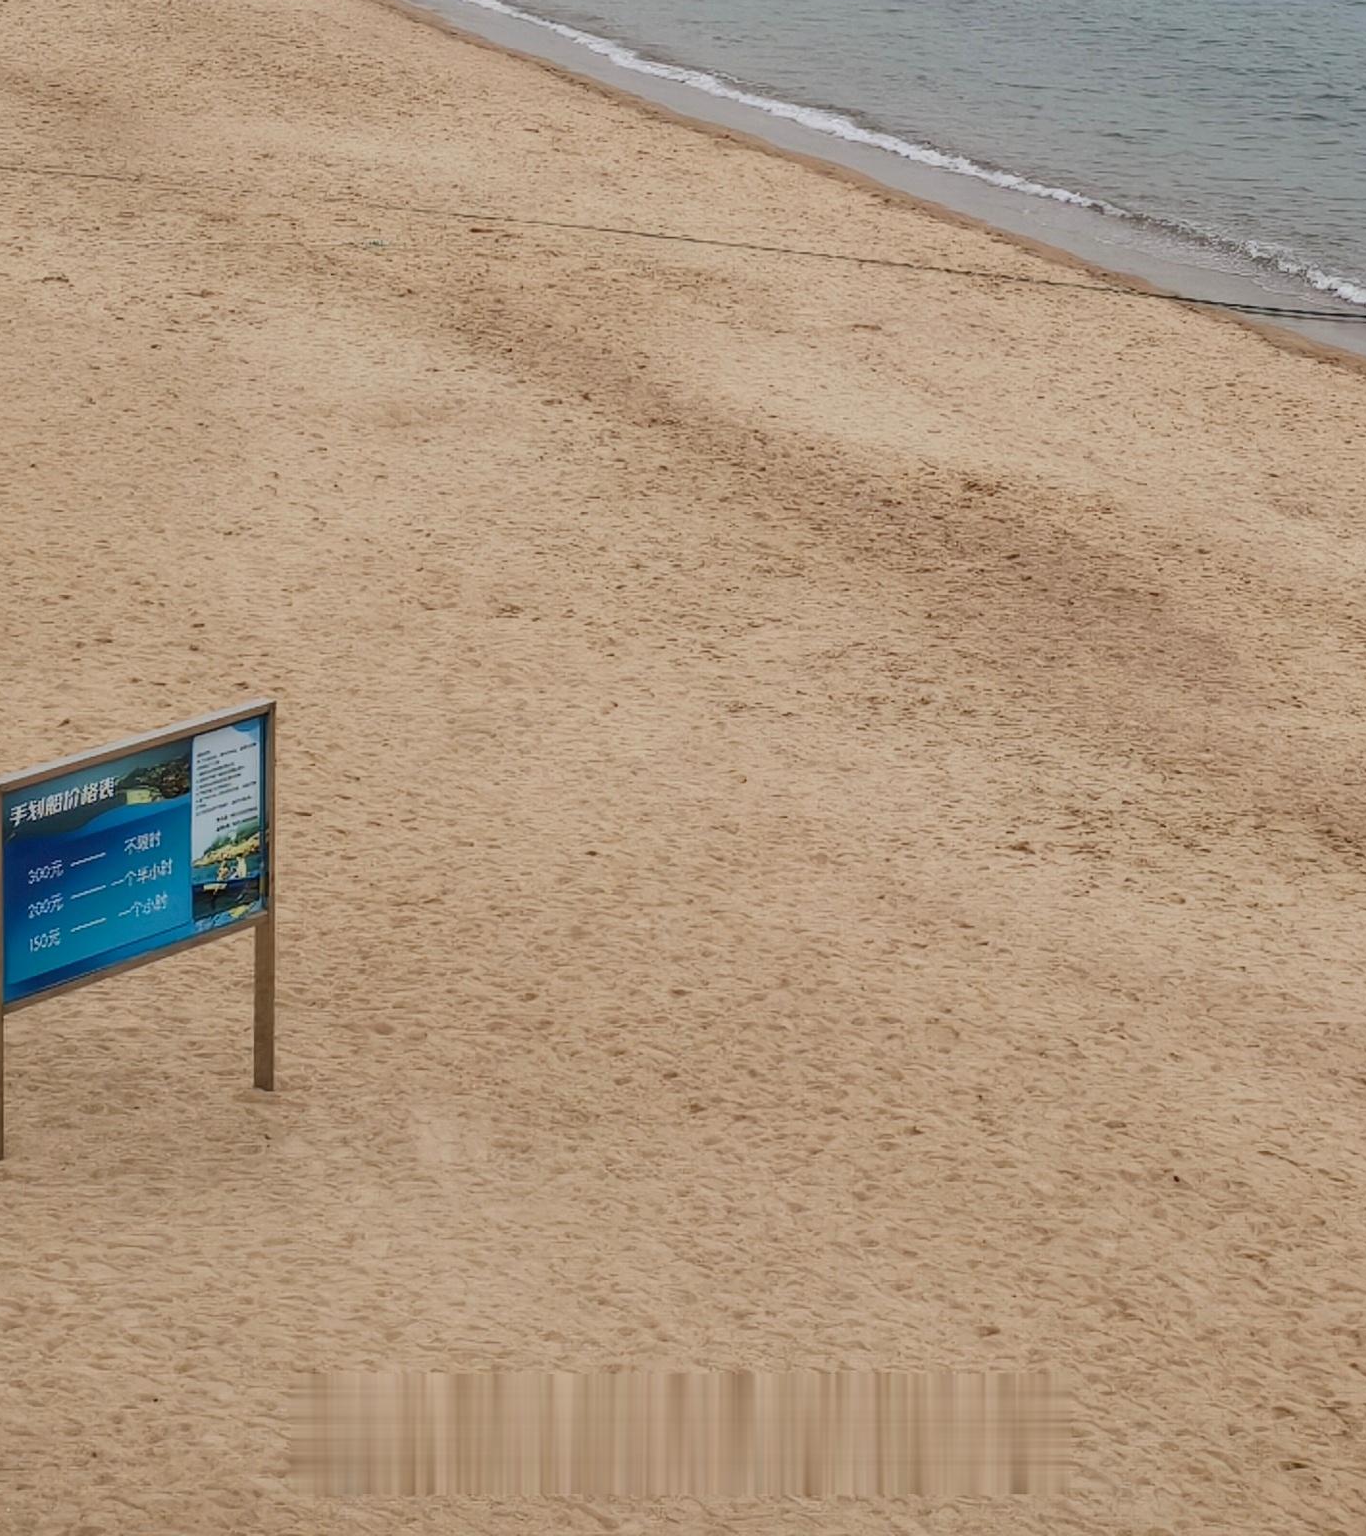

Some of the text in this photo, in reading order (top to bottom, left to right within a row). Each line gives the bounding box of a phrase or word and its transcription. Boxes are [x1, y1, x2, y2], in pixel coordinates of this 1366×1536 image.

[9, 777, 115, 826] 手划船价格表
[28, 860, 64, 884] 300元
[28, 893, 64, 919] 200元
[30, 927, 60, 952] 150元
